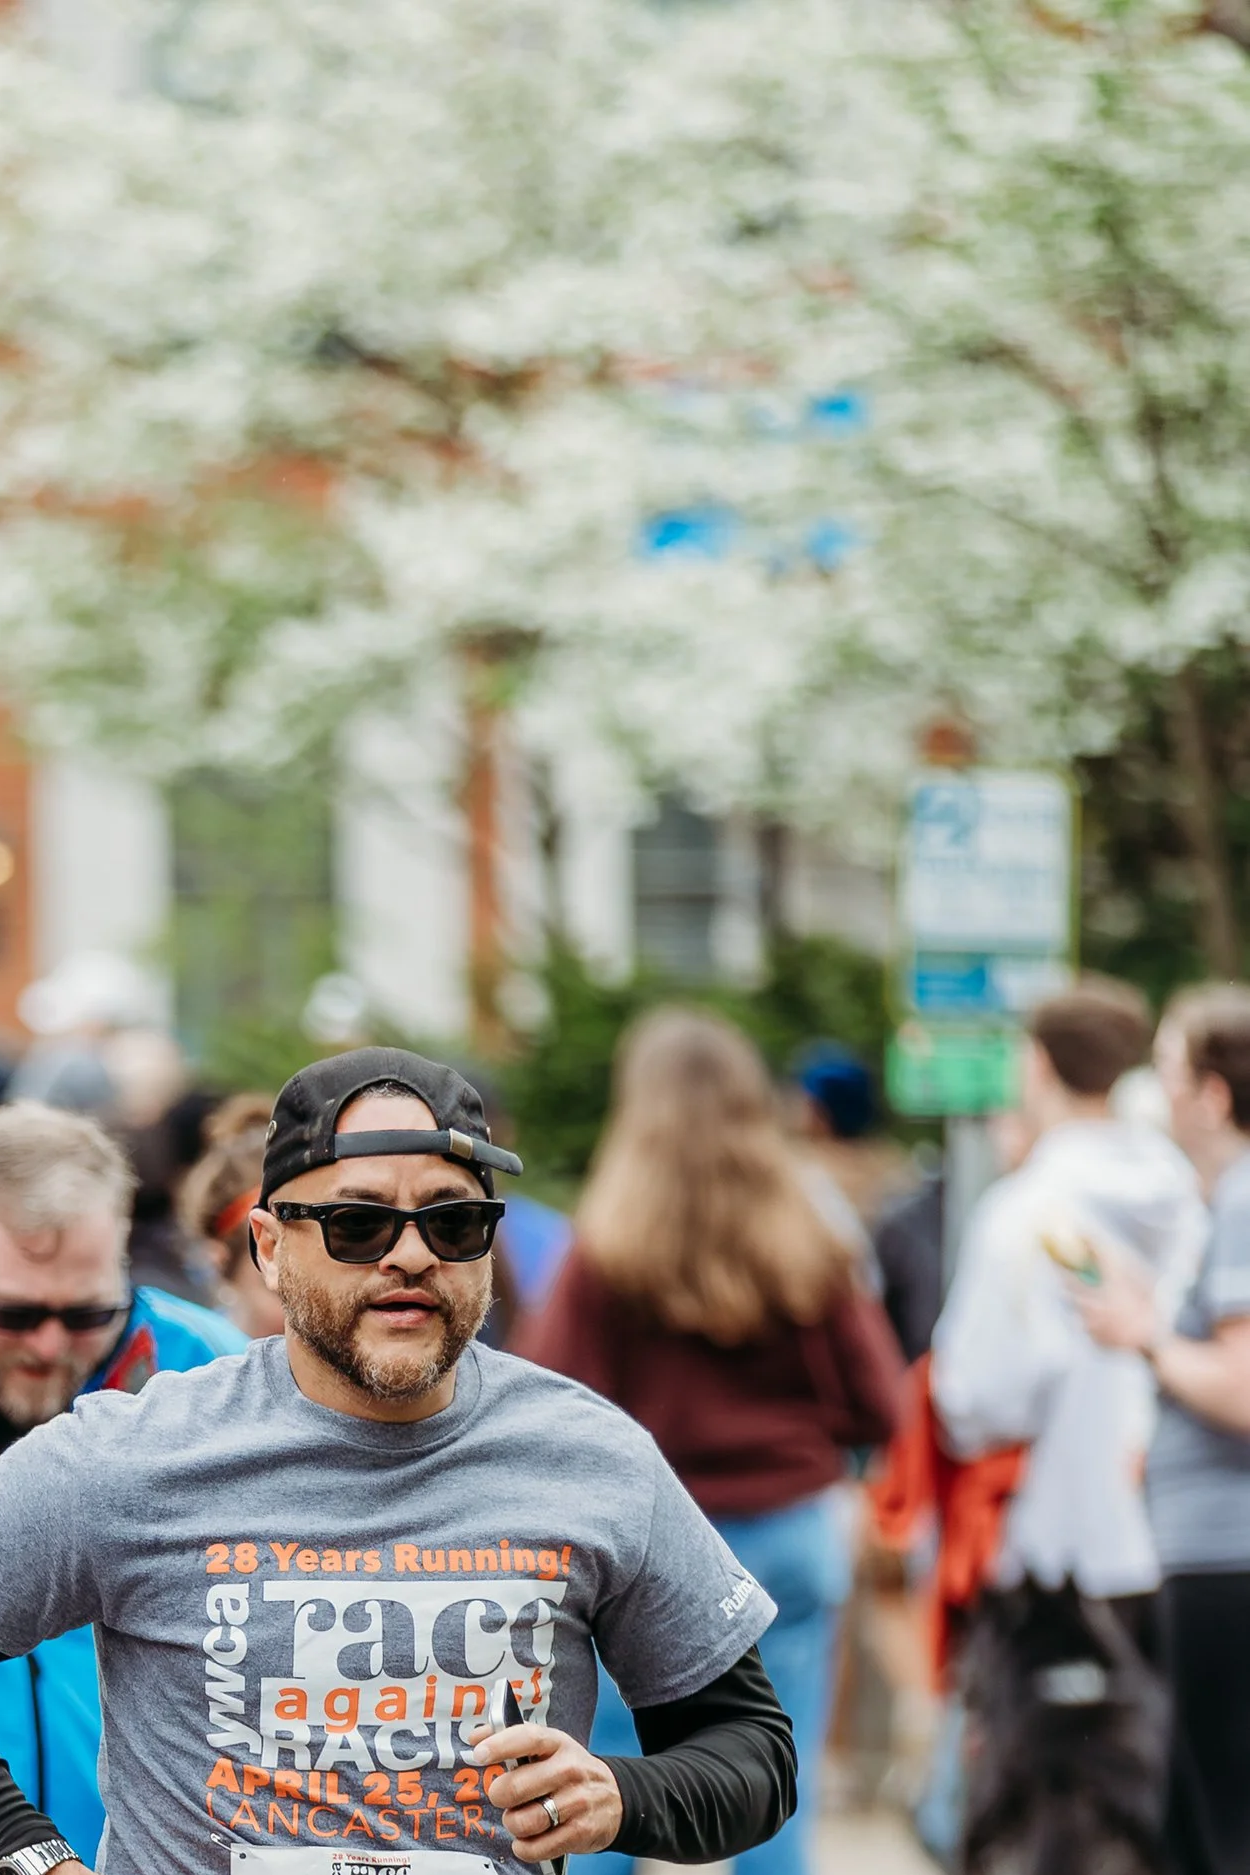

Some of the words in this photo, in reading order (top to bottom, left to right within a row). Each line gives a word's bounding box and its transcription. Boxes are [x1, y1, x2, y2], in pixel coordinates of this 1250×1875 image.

[205, 1542, 259, 1574] 28
[269, 1541, 383, 1573] Years
[393, 1538, 573, 1581] Running!
[262, 1594, 561, 1680] race
[202, 1582, 263, 1755] ywca
[260, 1720, 547, 1772] RACIS
[205, 1757, 350, 1804] APRIL
[362, 1770, 440, 1809] 25,
[206, 1791, 496, 1841] LANCASTER,
[346, 1853, 369, 1863] Years
